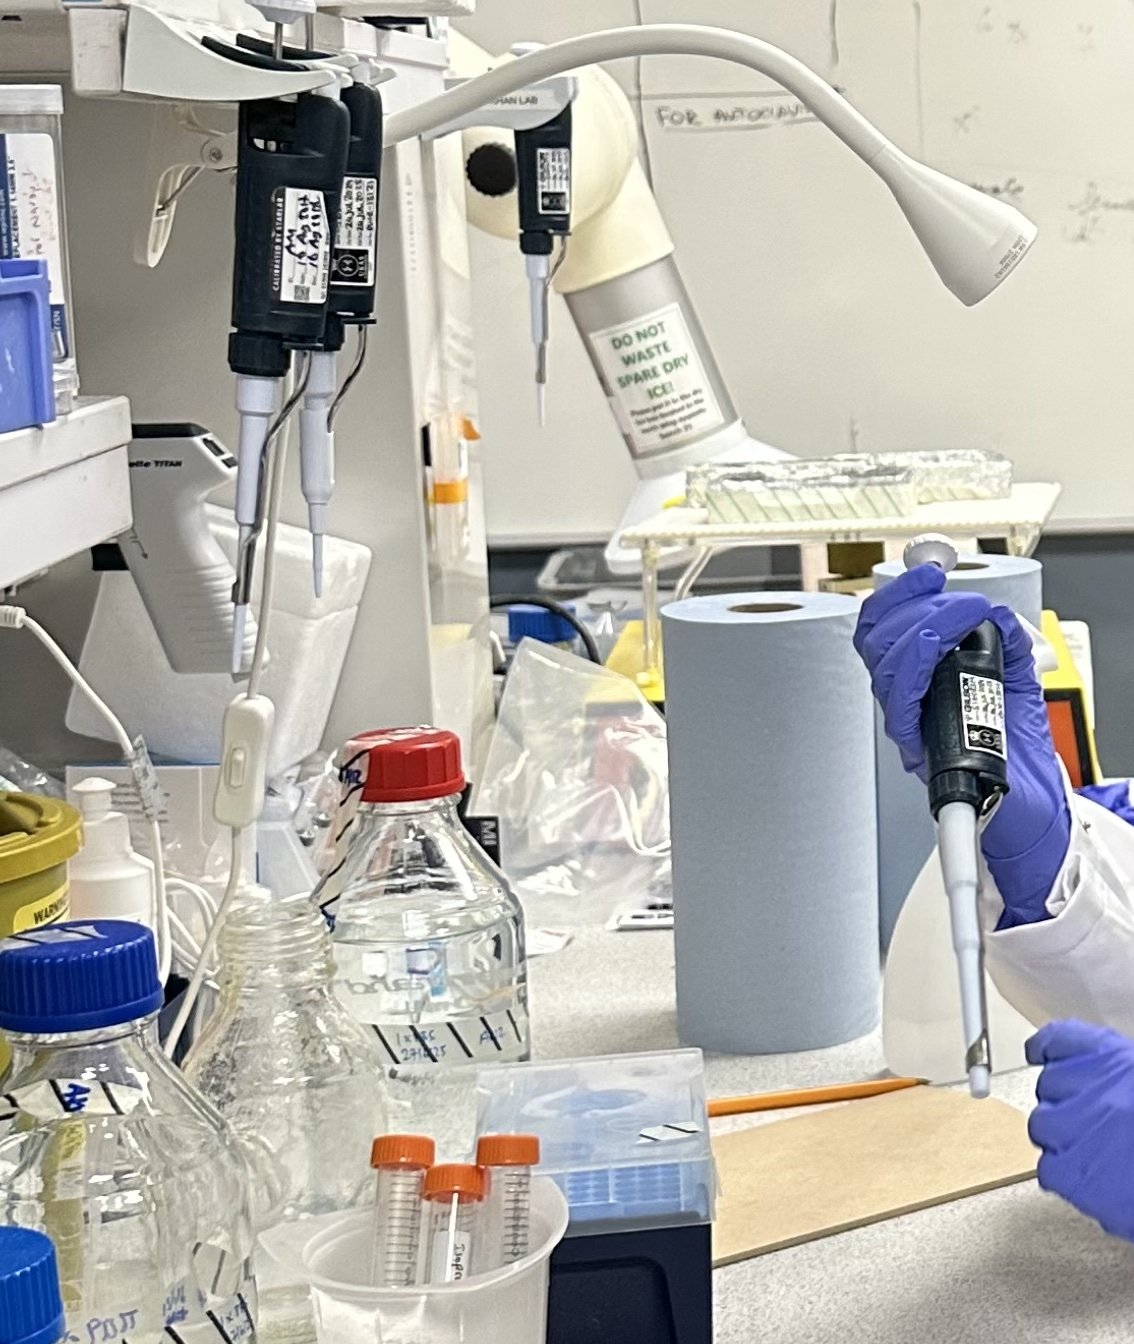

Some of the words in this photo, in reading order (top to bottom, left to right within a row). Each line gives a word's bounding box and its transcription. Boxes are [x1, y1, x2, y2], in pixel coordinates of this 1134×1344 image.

[657, 105, 701, 127] FOR
[611, 333, 633, 351] DO
[635, 321, 666, 343] NOT
[621, 341, 671, 367] WASTE
[617, 366, 660, 390] SPARE
[662, 353, 690, 375] DRY
[153, 459, 183, 468] TITAN
